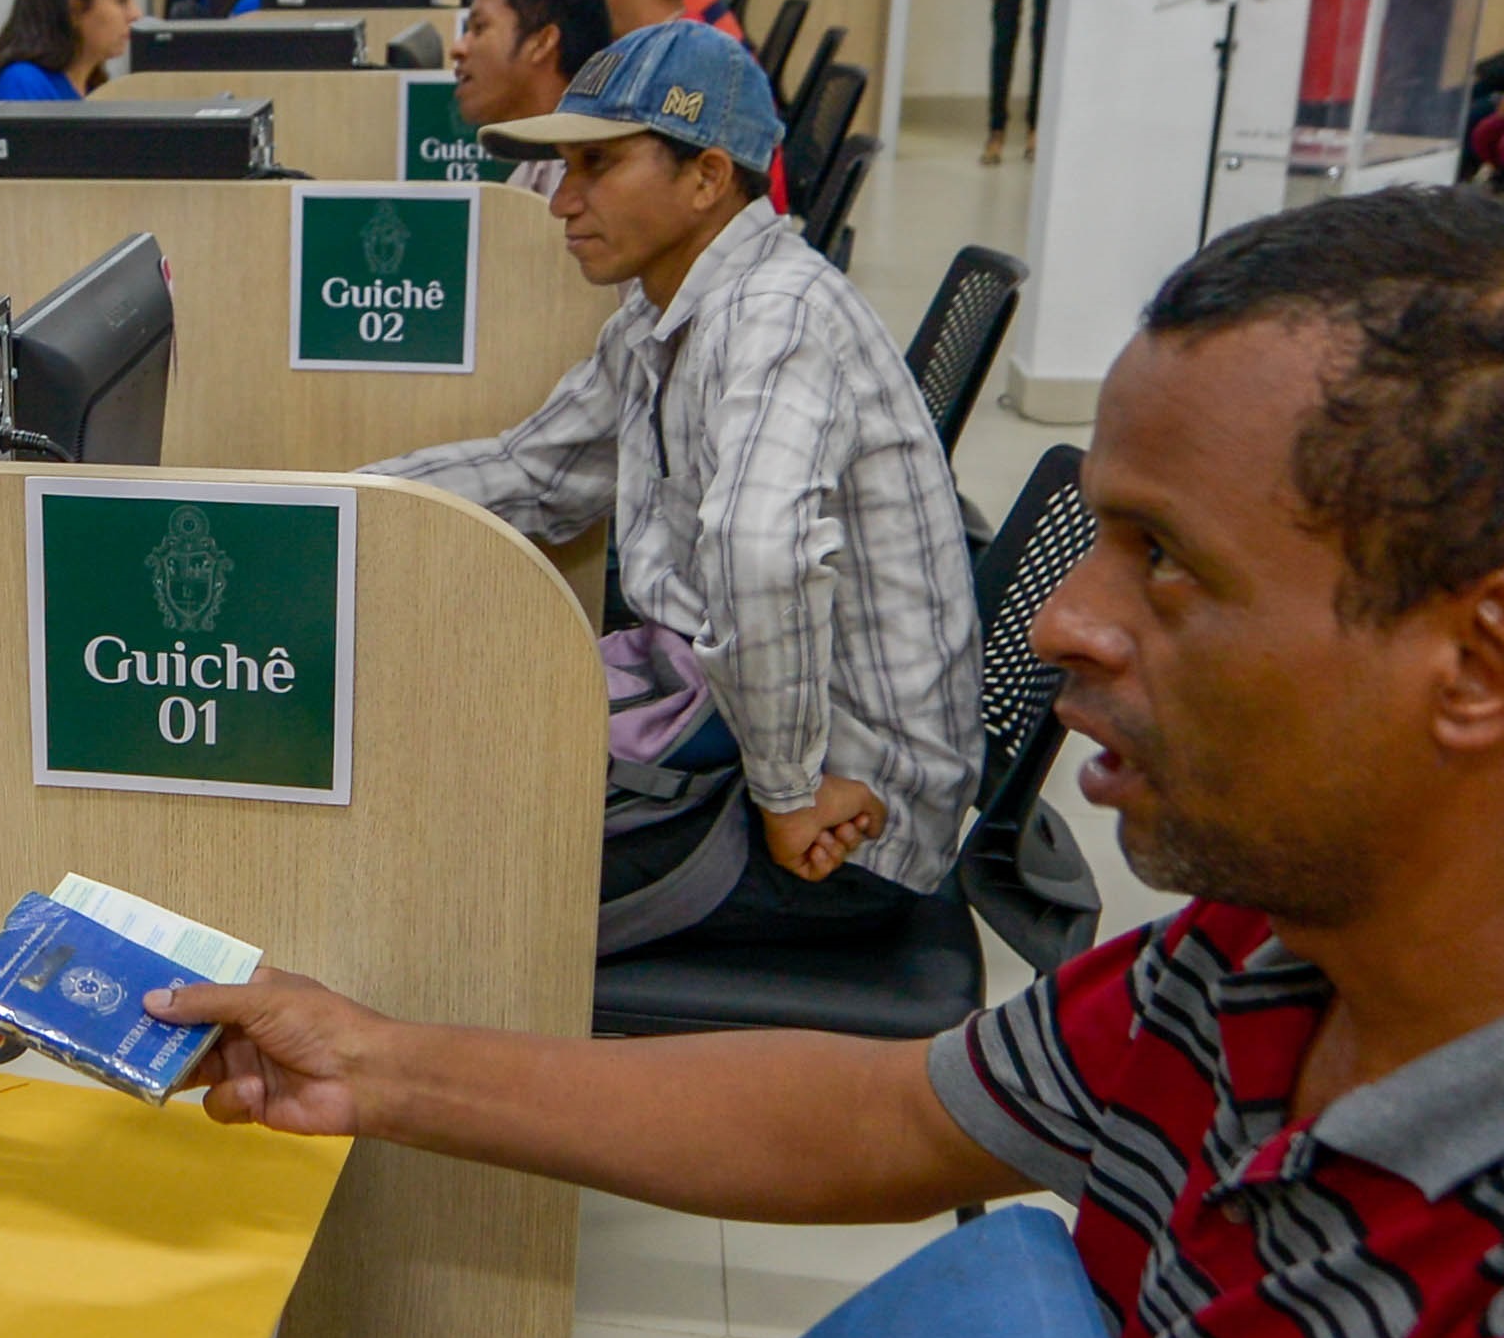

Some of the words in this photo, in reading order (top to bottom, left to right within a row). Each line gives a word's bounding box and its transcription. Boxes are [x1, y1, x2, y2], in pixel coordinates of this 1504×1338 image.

[420, 137, 491, 162] Guic
[446, 163, 480, 181] 03
[321, 277, 444, 310] Guichê
[358, 312, 404, 342] 02
[84, 635, 295, 693] Guichê
[158, 695, 217, 745] 01
